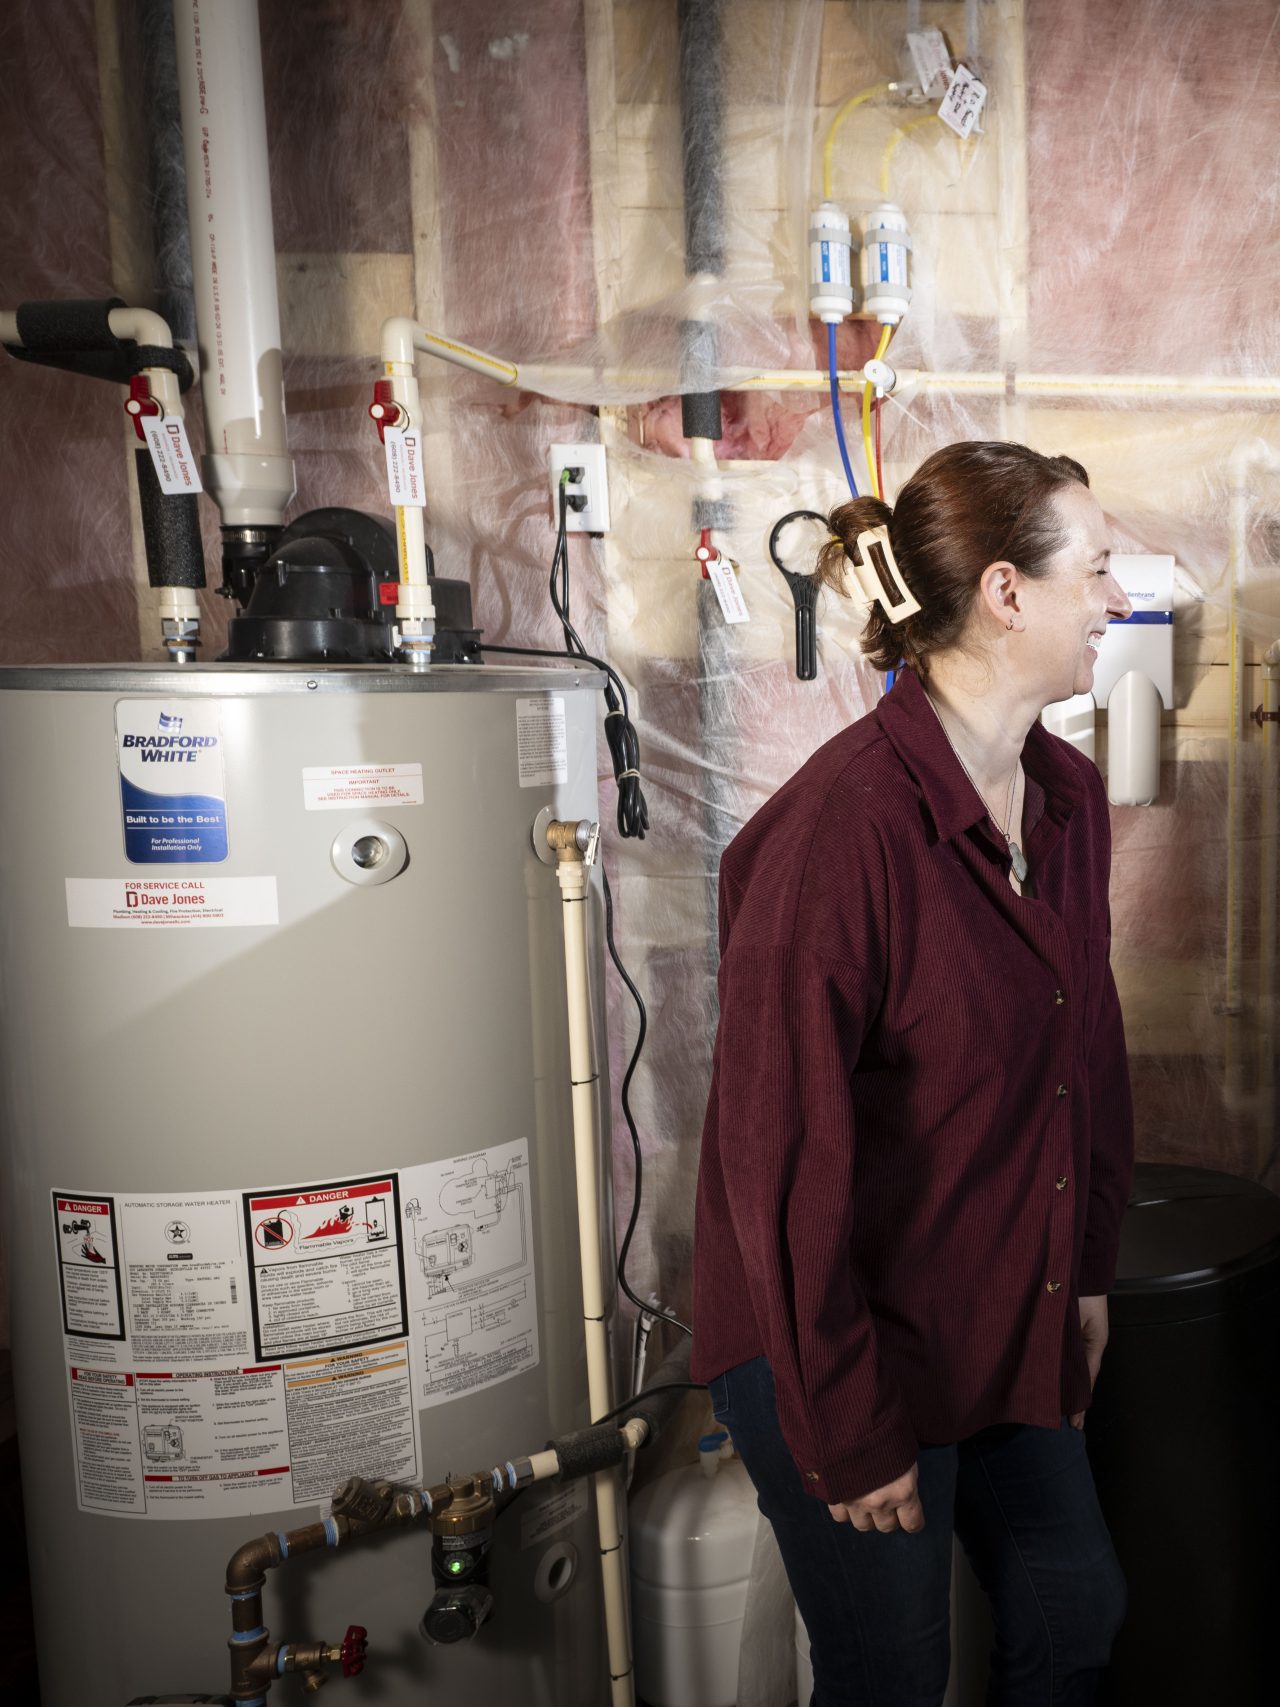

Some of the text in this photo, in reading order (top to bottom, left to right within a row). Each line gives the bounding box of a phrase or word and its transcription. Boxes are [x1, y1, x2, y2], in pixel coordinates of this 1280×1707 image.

[171, 436, 192, 486] Dave Jones
[407, 450, 418, 500] Dave Jones
[123, 734, 217, 748] BRADFORD
[141, 749, 198, 763] WHITE
[126, 815, 220, 824] Built to be the Best
[151, 837, 200, 845] For Professional
[187, 844, 202, 852] Only
[125, 881, 205, 890] FOR SERVICE CALL
[141, 893, 205, 905] Dave Jones
[309, 1191, 349, 1204] DANGER
[72, 1204, 102, 1213] DANGER
[299, 1238, 354, 1250] Flammable Vapors
[336, 1352, 363, 1361] WARNING
[203, 1369, 239, 1377] INSTRUCTIONS
[338, 1371, 364, 1380] WARNING
